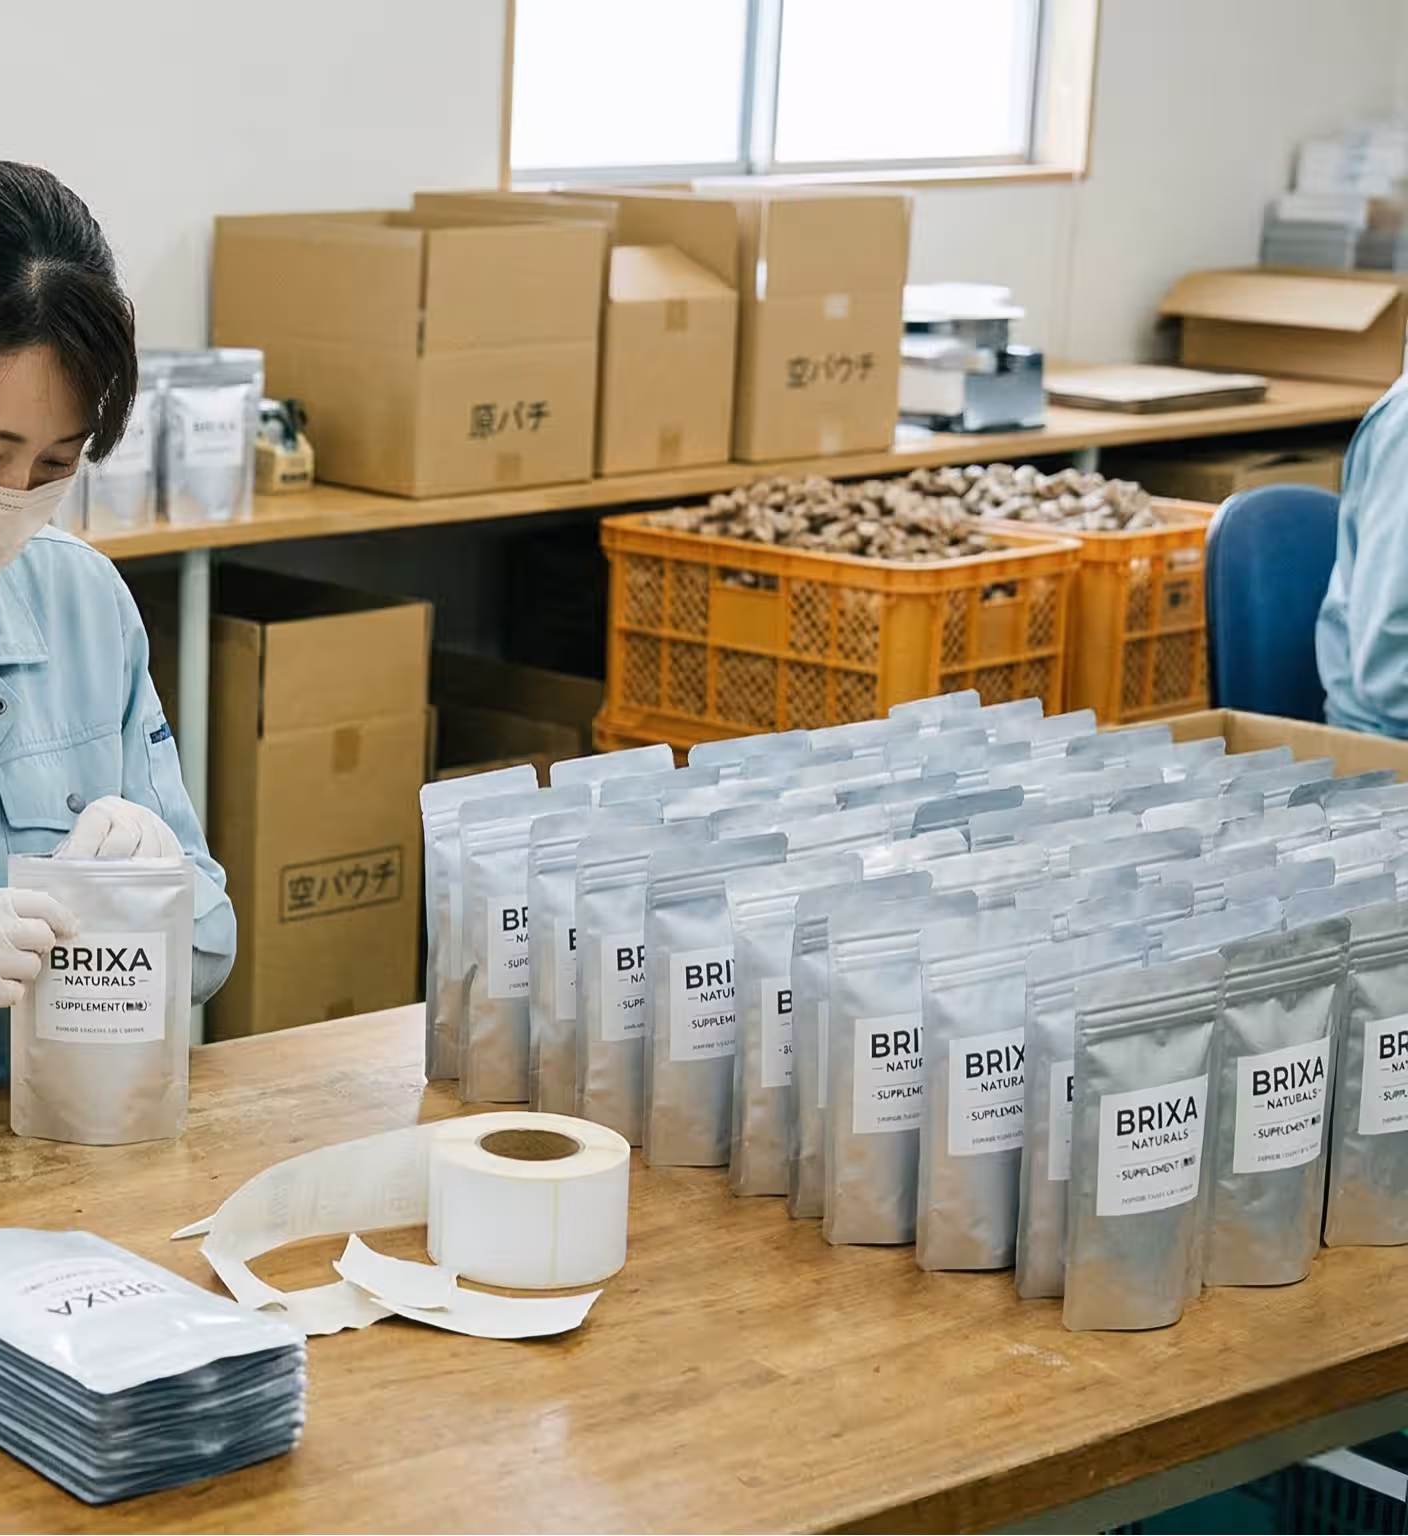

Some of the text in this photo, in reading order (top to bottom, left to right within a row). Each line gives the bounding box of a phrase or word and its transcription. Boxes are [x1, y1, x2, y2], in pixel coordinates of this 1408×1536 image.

[50, 946, 152, 972] BRIXA
[685, 959, 735, 989] BRI
[64, 975, 136, 987] NATURALS
[871, 1027, 924, 1058] BRI
[1252, 1056, 1324, 1096] BRIXA
[1116, 1096, 1198, 1136] BRIXA
[1131, 1128, 1189, 1150] NATURALS
